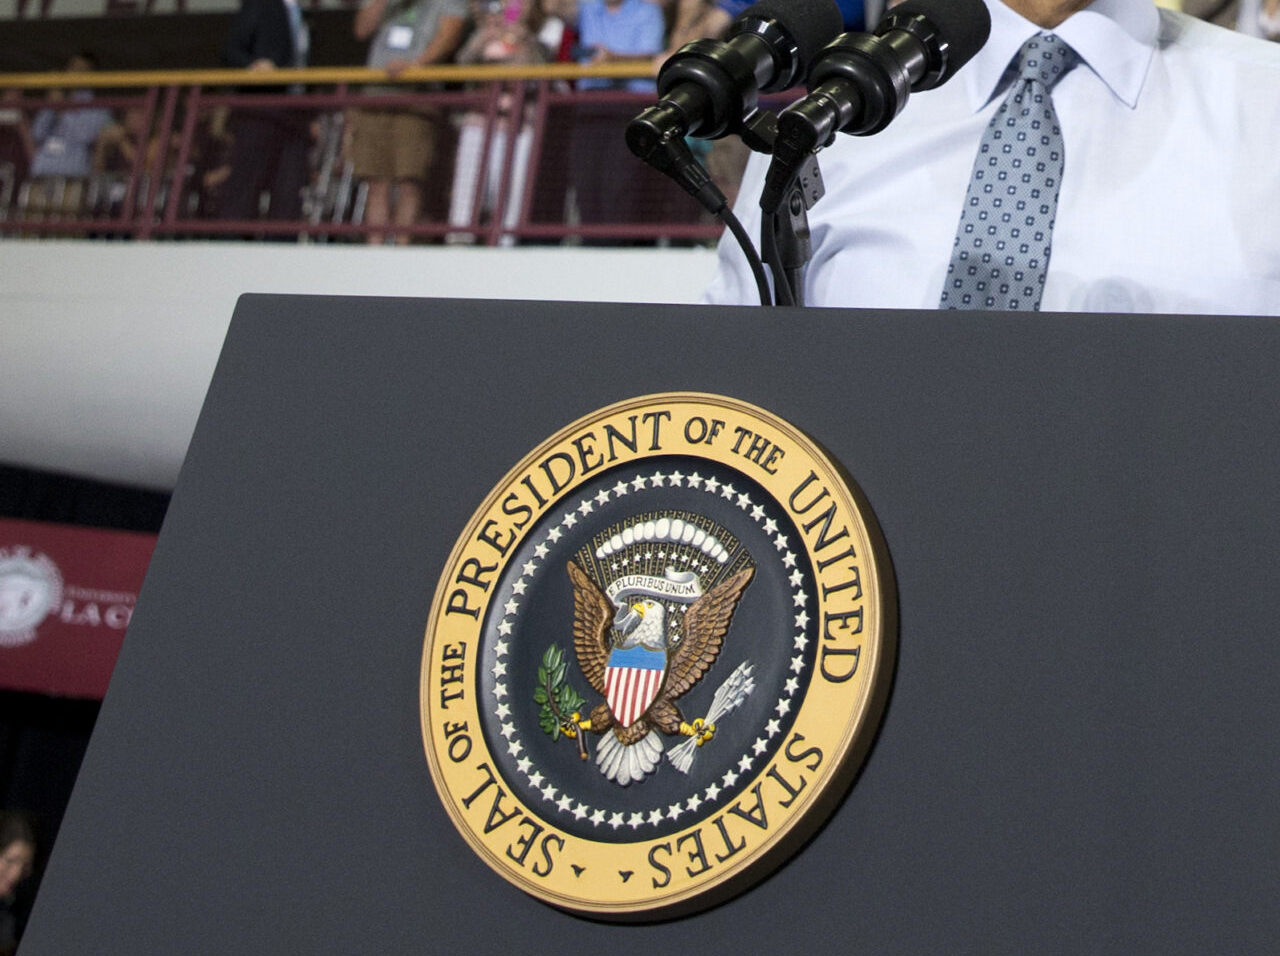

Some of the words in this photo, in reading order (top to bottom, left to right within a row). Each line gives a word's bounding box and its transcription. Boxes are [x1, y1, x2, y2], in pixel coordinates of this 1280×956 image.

[684, 416, 726, 446] OF
[732, 425, 785, 475] THE
[446, 410, 672, 622] PRESIDENT
[608, 586, 616, 597] E
[616, 576, 665, 591] PLURIBUS
[665, 583, 696, 595] UNUM
[788, 471, 864, 684] UNITED
[440, 641, 467, 708] THE
[445, 720, 472, 763] OF
[462, 763, 565, 878] SEAL
[648, 733, 824, 889] STATES
